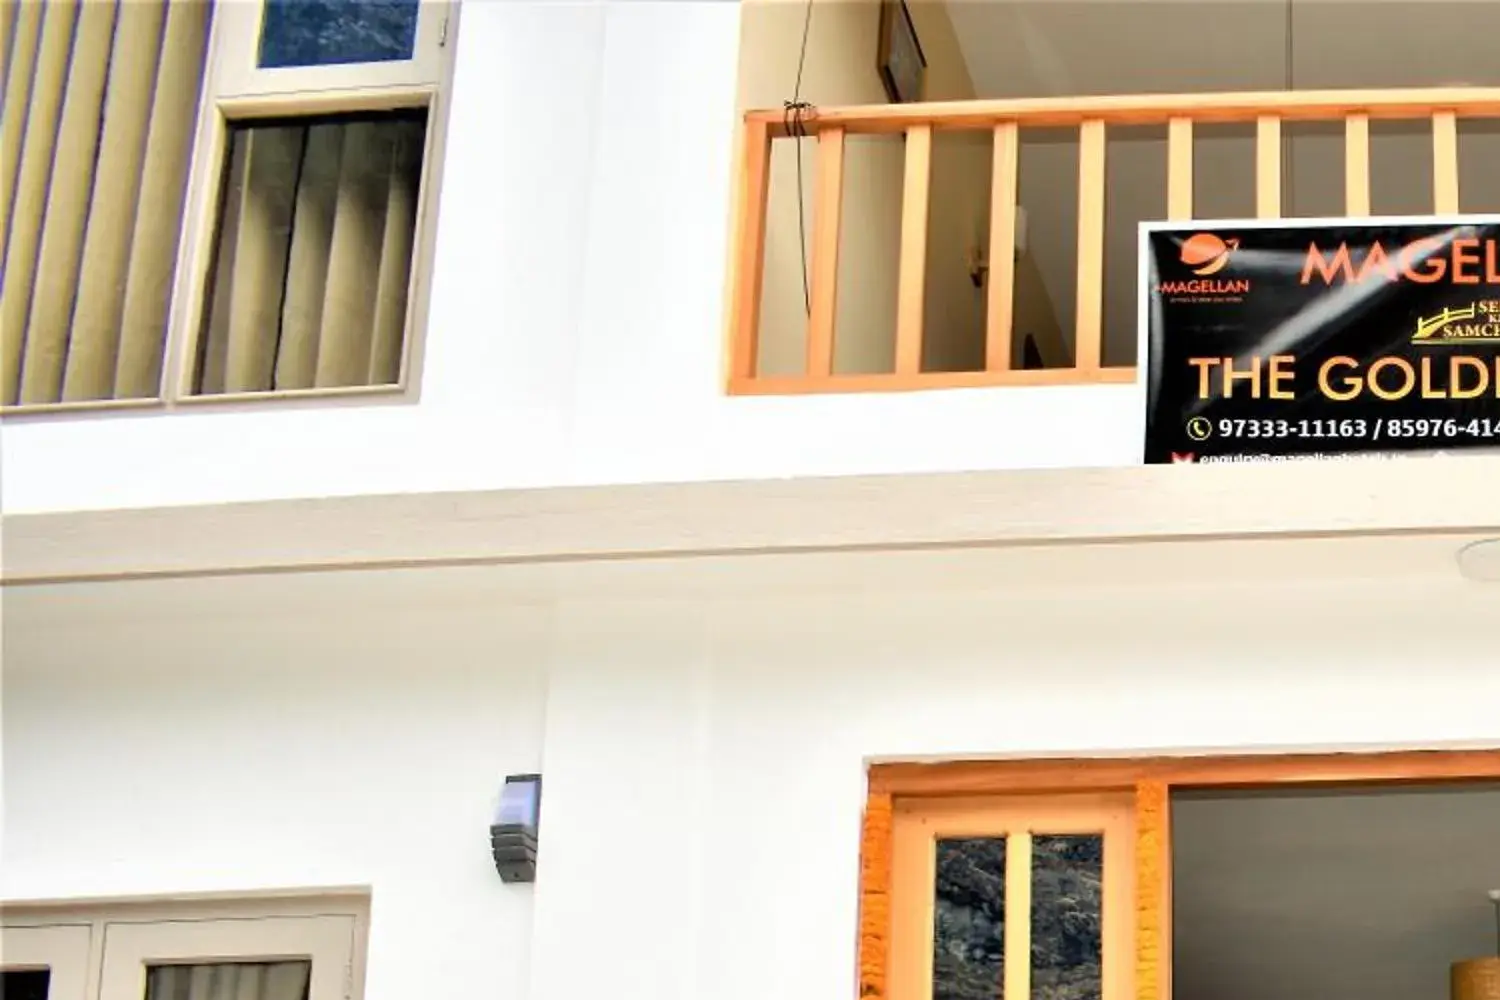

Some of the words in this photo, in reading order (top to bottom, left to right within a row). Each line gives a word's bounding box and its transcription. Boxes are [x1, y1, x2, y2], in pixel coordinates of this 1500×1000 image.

[1160, 279, 1249, 294] MAGELLAN
[1188, 354, 1296, 400] THE
[1218, 418, 1368, 438] 97333-11163
[1372, 418, 1382, 441] /
